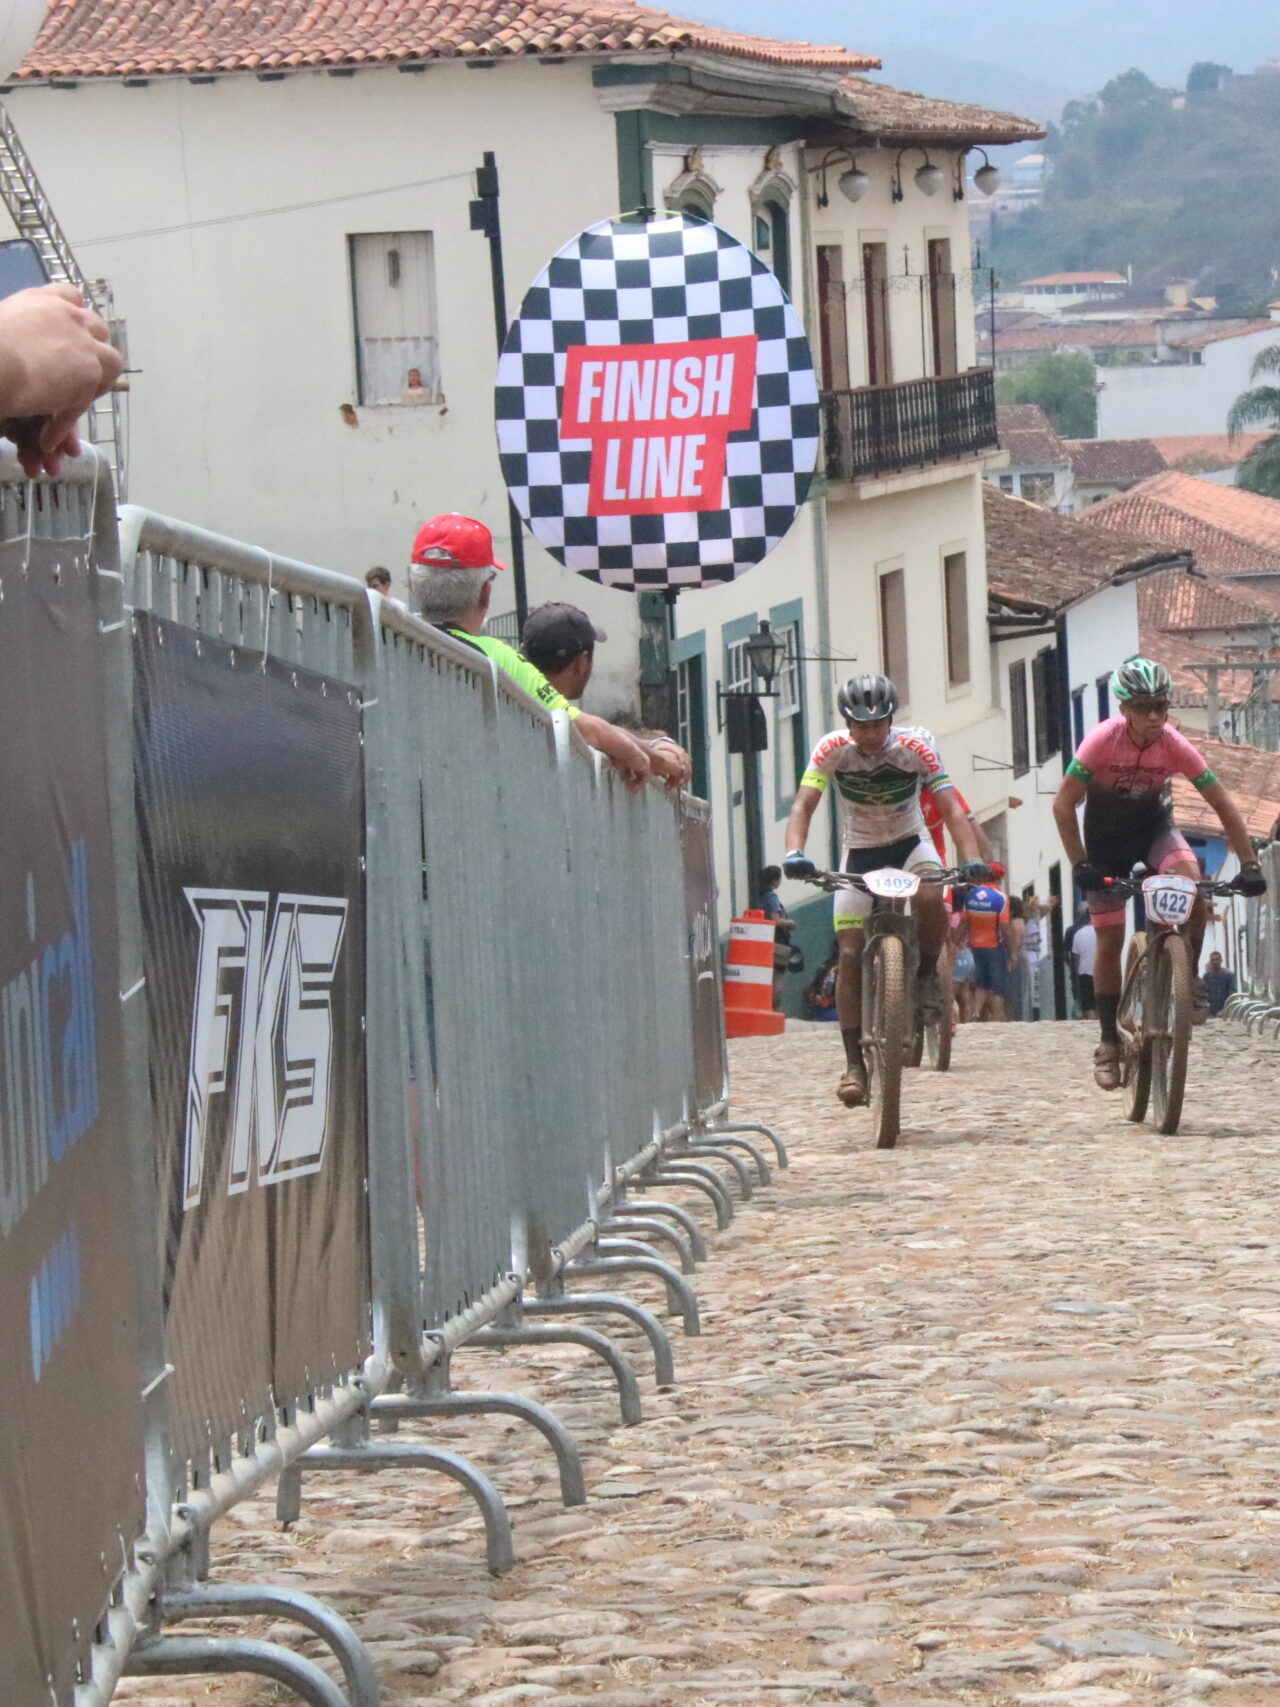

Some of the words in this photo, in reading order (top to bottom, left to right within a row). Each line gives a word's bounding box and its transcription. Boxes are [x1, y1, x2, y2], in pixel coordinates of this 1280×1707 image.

[576, 353, 735, 424] FINISH
[603, 434, 706, 501] LINE
[896, 735, 941, 774] KENDA
[874, 878, 913, 889] 1409
[182, 886, 349, 1212] FKS
